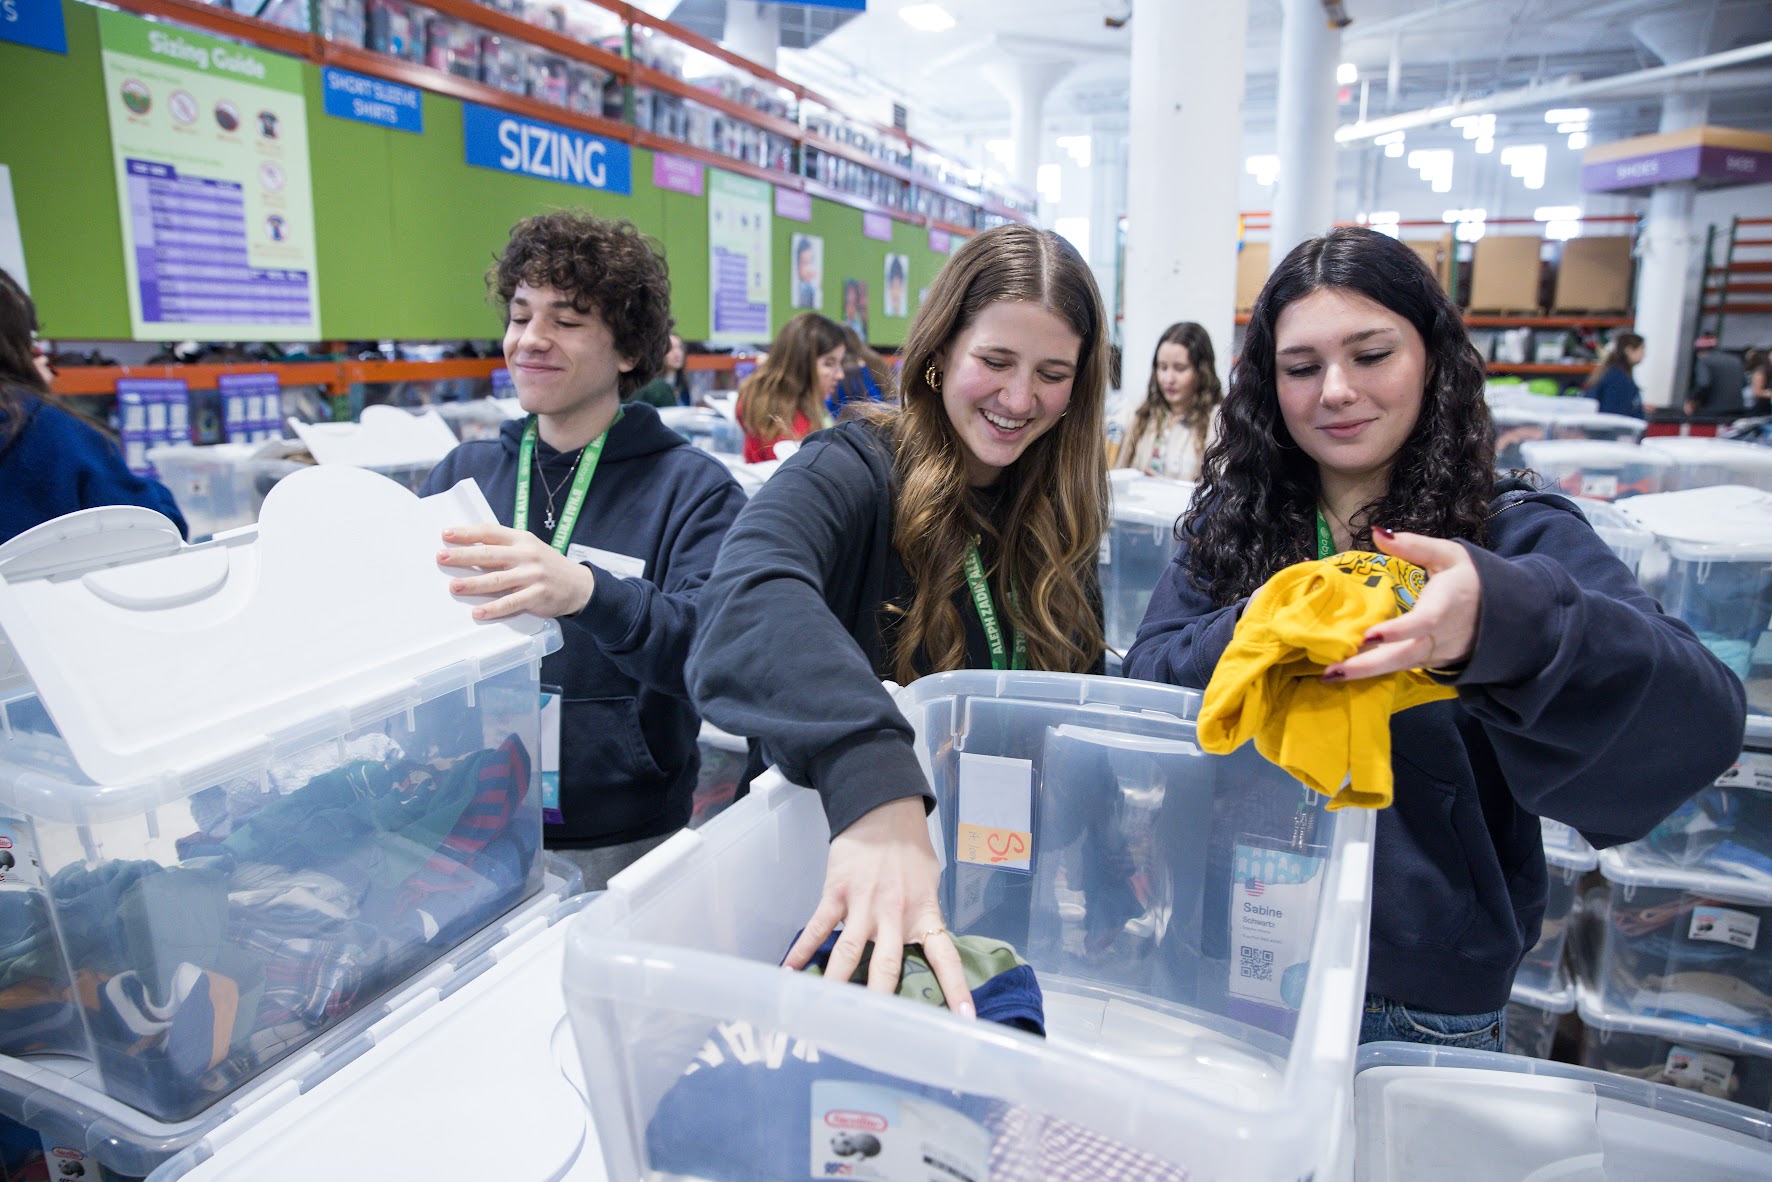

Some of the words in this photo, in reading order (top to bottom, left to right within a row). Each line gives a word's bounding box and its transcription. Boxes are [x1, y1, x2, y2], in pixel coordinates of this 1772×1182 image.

[149, 29, 209, 69] Sizing
[211, 46, 265, 79] Guide
[352, 97, 398, 124] SHIRTS
[498, 119, 607, 188] SIZING
[1320, 539, 1330, 556] bby
[972, 580, 993, 616] ZADIK
[984, 618, 1003, 654] ALEPH
[1243, 902, 1282, 918] Sabine
